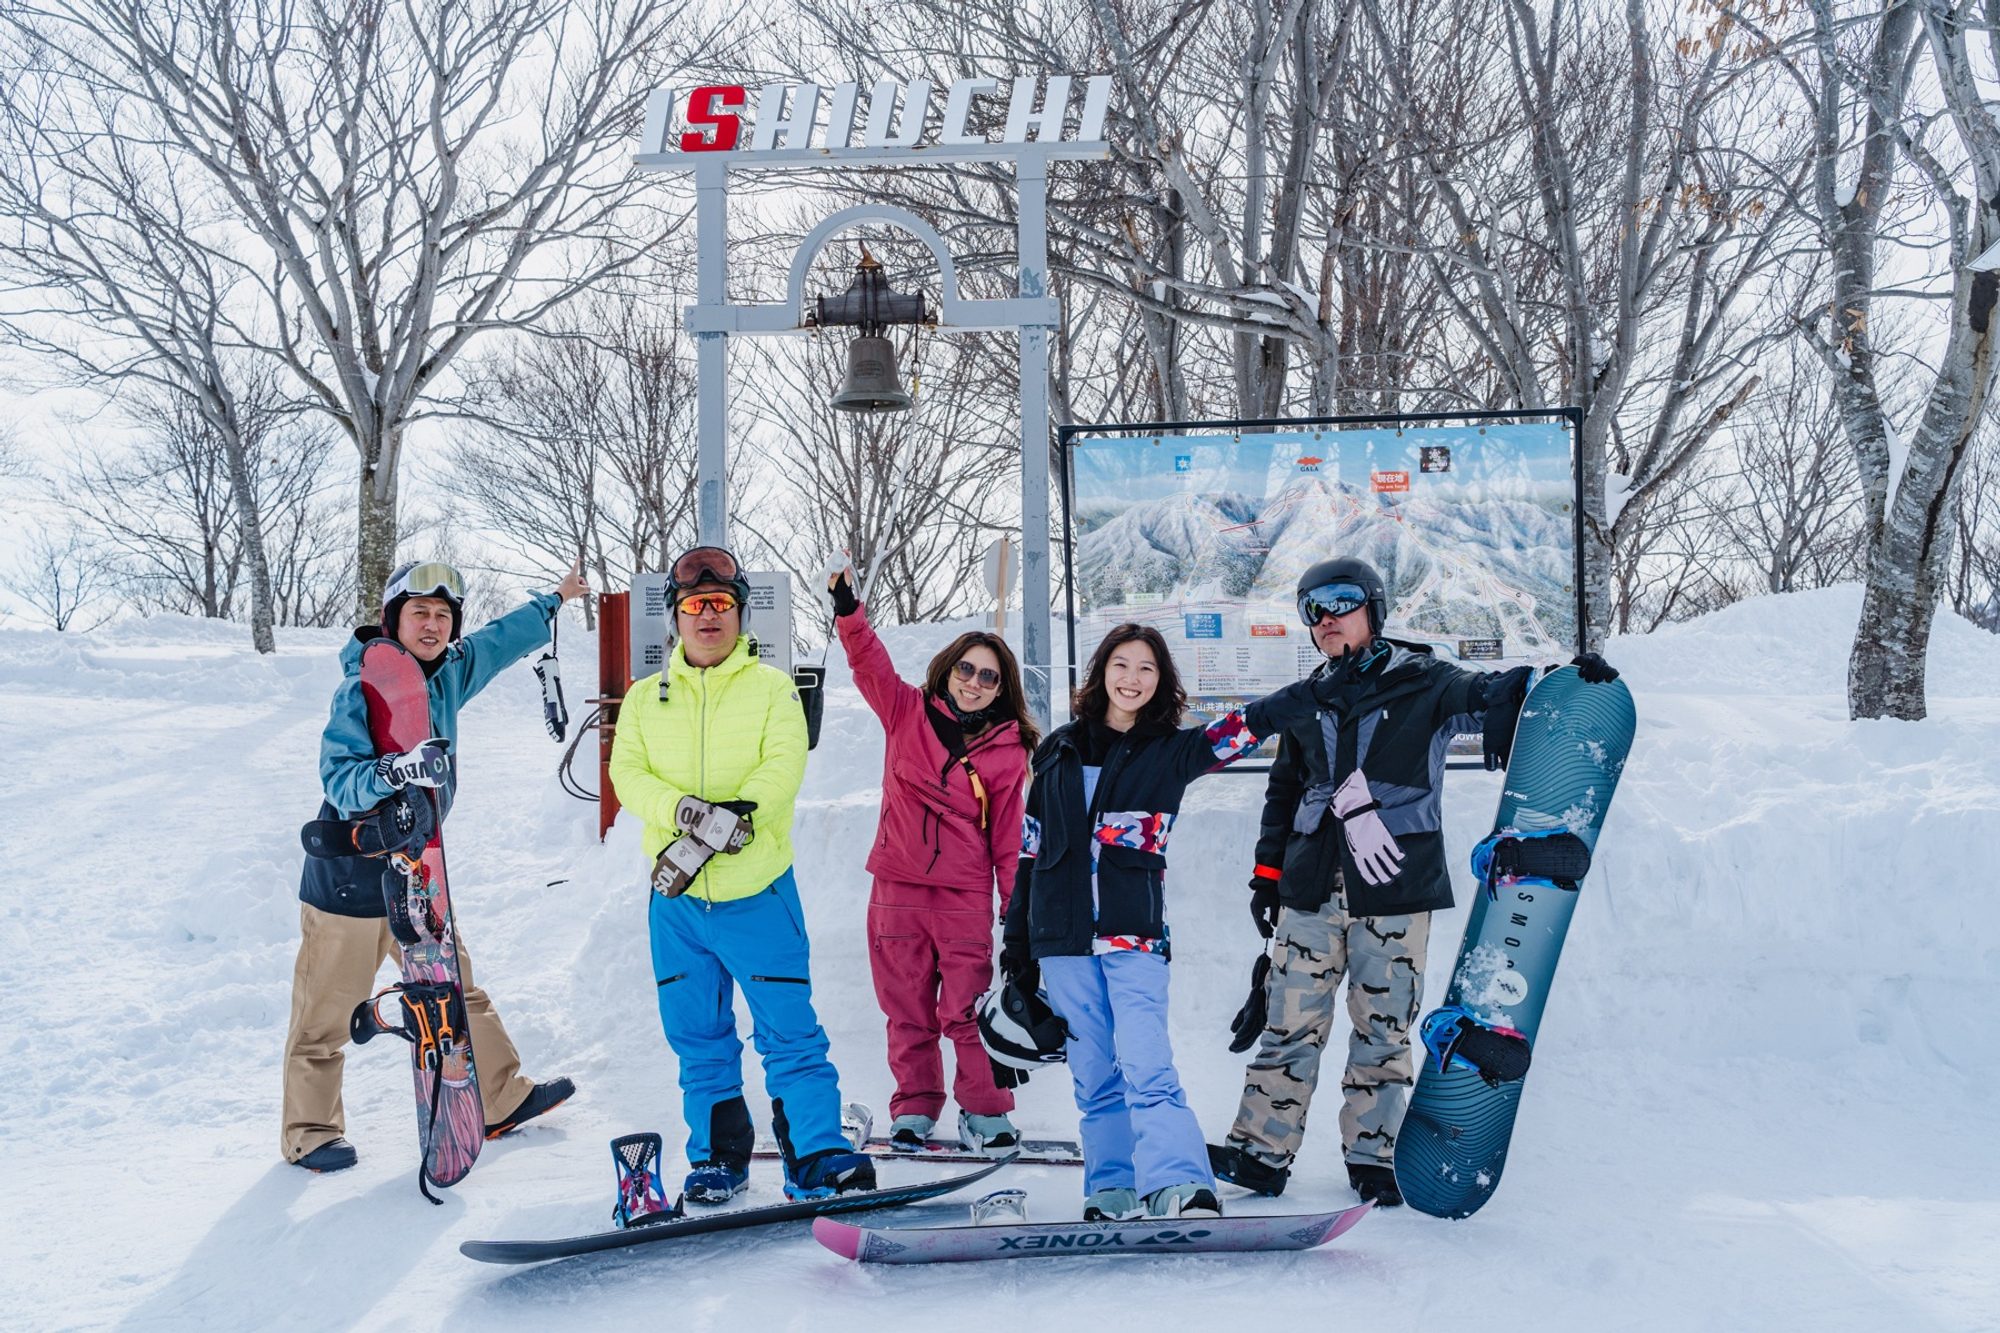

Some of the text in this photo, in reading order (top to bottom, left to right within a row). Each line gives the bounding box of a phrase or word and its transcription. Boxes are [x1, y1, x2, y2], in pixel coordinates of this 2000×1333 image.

[638, 75, 1113, 154] ISHIUCHI
[1376, 473, 1404, 483] 現在地
[1187, 702, 1246, 712] 三山共通券の
[998, 1234, 1125, 1251] YONEX
